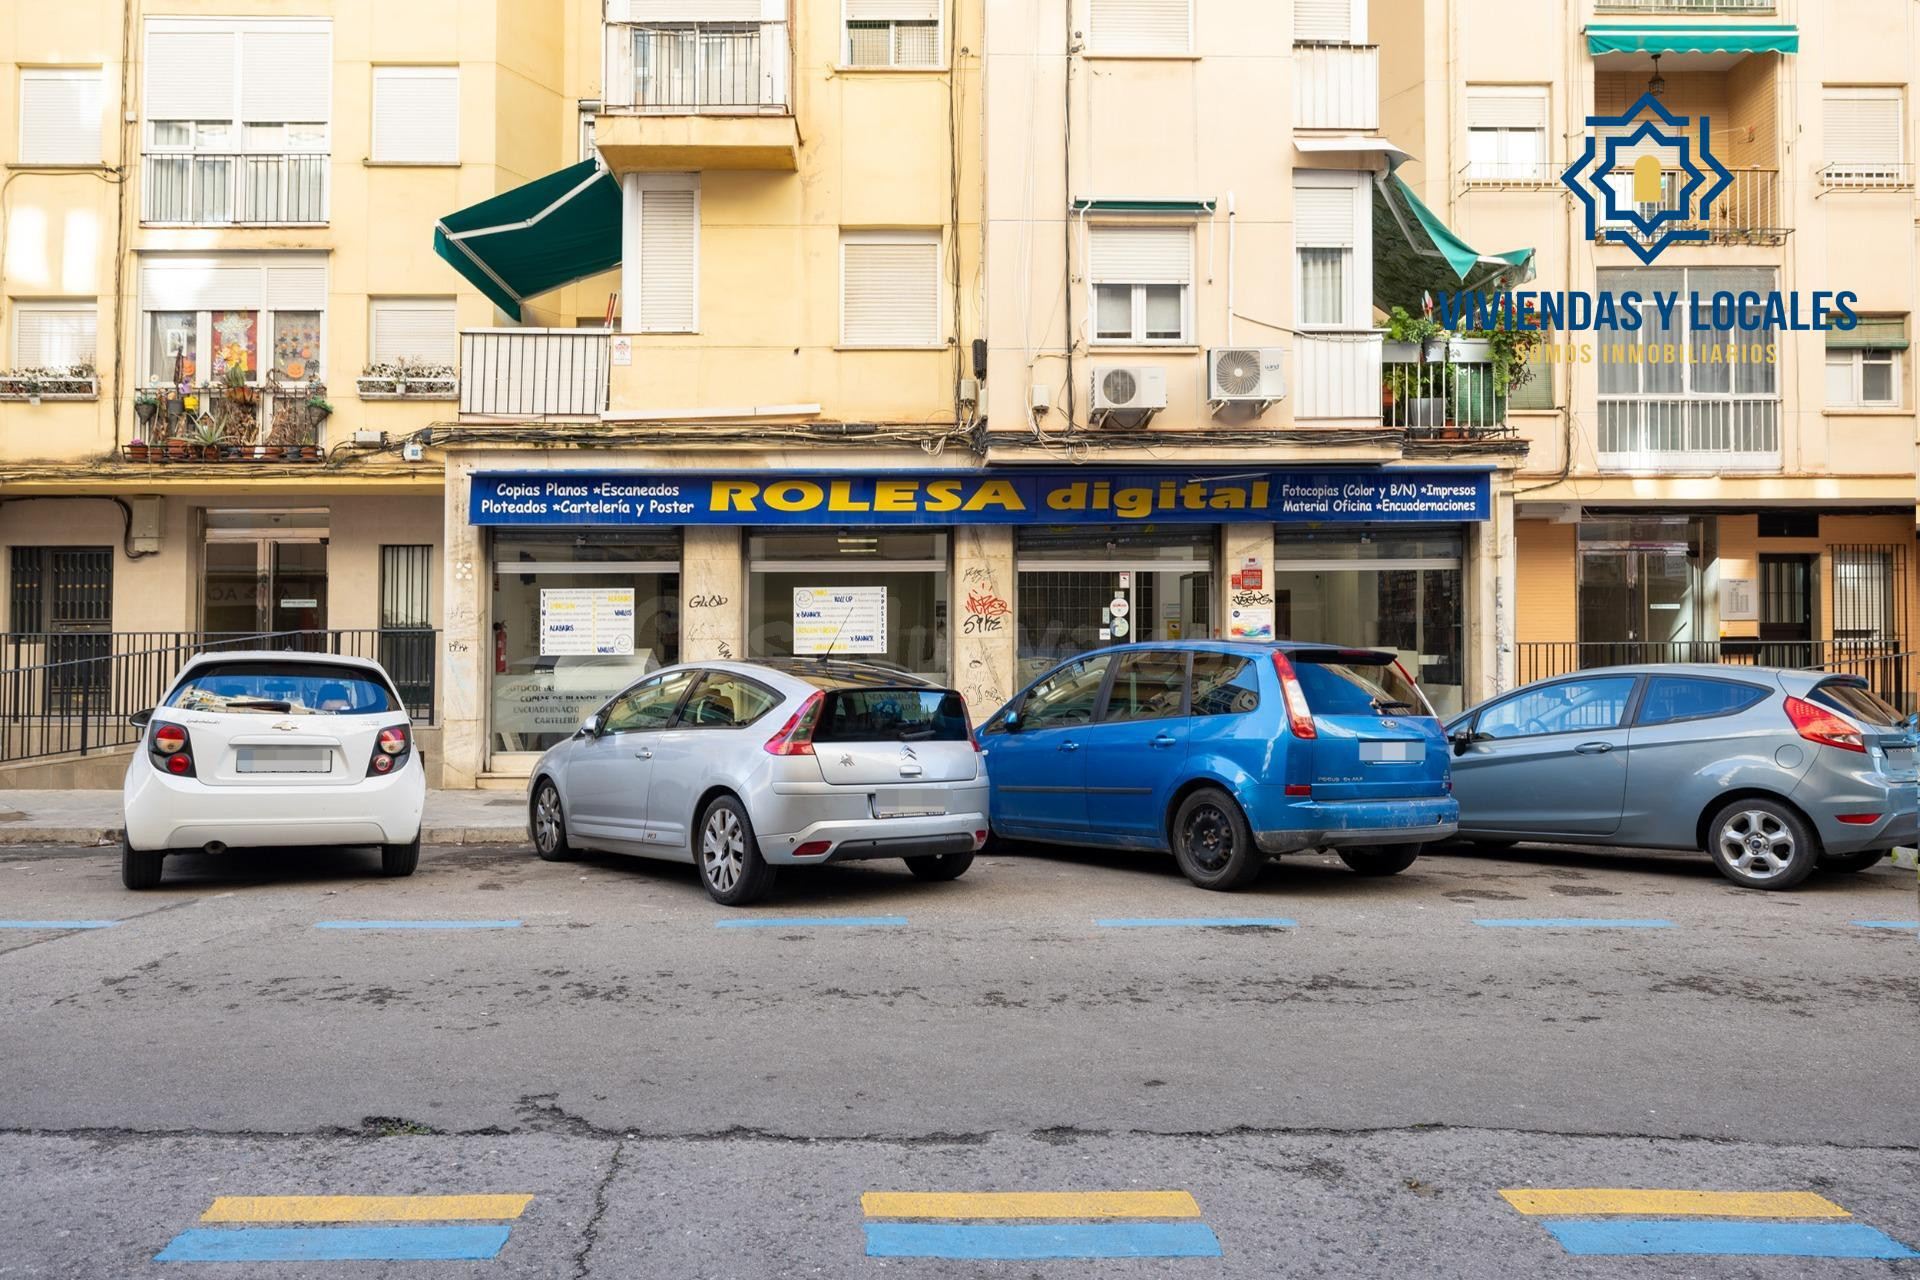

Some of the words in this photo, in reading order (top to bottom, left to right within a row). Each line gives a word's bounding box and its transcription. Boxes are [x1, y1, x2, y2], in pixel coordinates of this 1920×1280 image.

[496, 483, 540, 500] Copias
[546, 483, 588, 496] Planos
[709, 481, 1026, 512] ROLESA
[1046, 481, 1270, 518] digital
[1282, 484, 1339, 500] Fotocopias
[1343, 484, 1375, 498] (Color
[1379, 487, 1386, 499] y
[1390, 484, 1417, 498] B/N)
[481, 499, 547, 514] Ploteados
[636, 503, 645, 517] y
[649, 500, 695, 514] Poster
[1282, 499, 1329, 512] Material
[1333, 499, 1372, 512] Oficina
